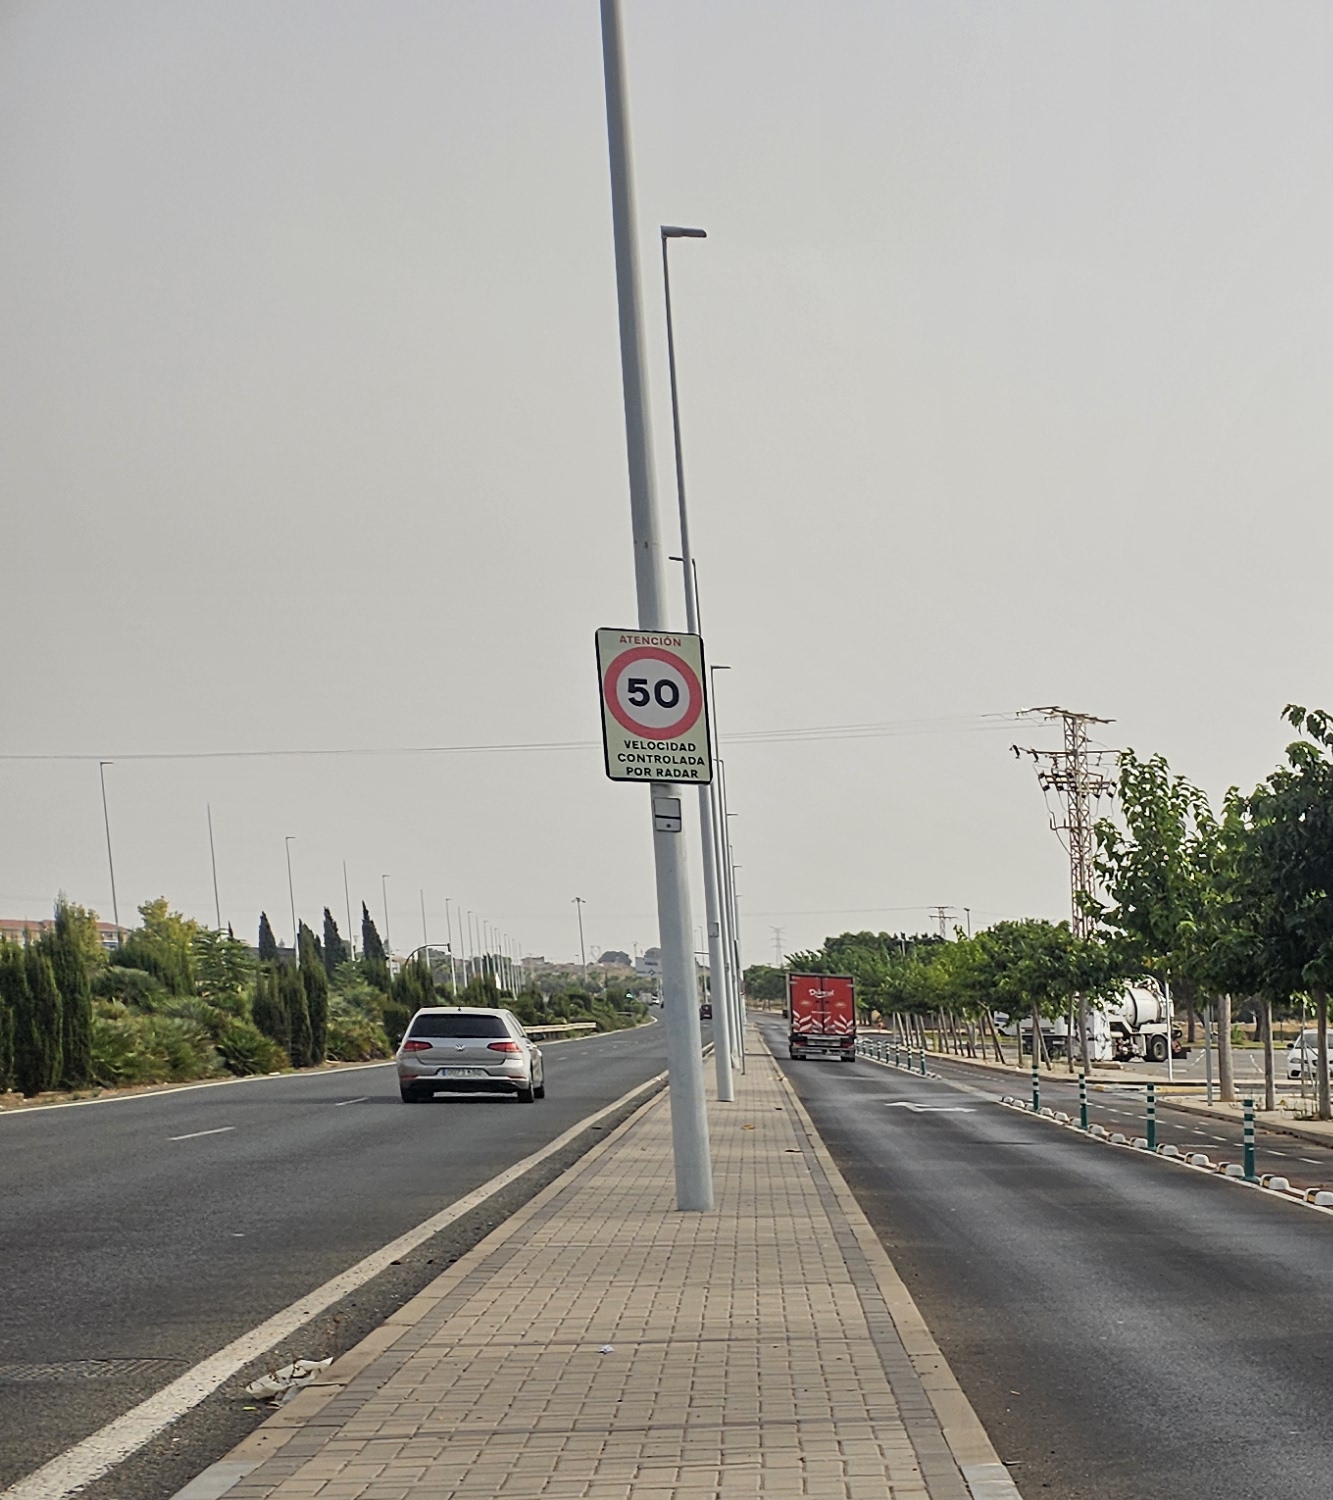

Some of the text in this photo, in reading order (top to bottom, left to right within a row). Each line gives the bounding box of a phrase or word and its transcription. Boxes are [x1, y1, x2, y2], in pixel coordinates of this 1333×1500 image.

[619, 635, 682, 647] ATENCIÓN
[627, 677, 680, 709] 50
[623, 740, 696, 752] VELOCIDAD
[617, 753, 706, 766] CONTROLADA
[626, 766, 699, 779] POR RADAR
